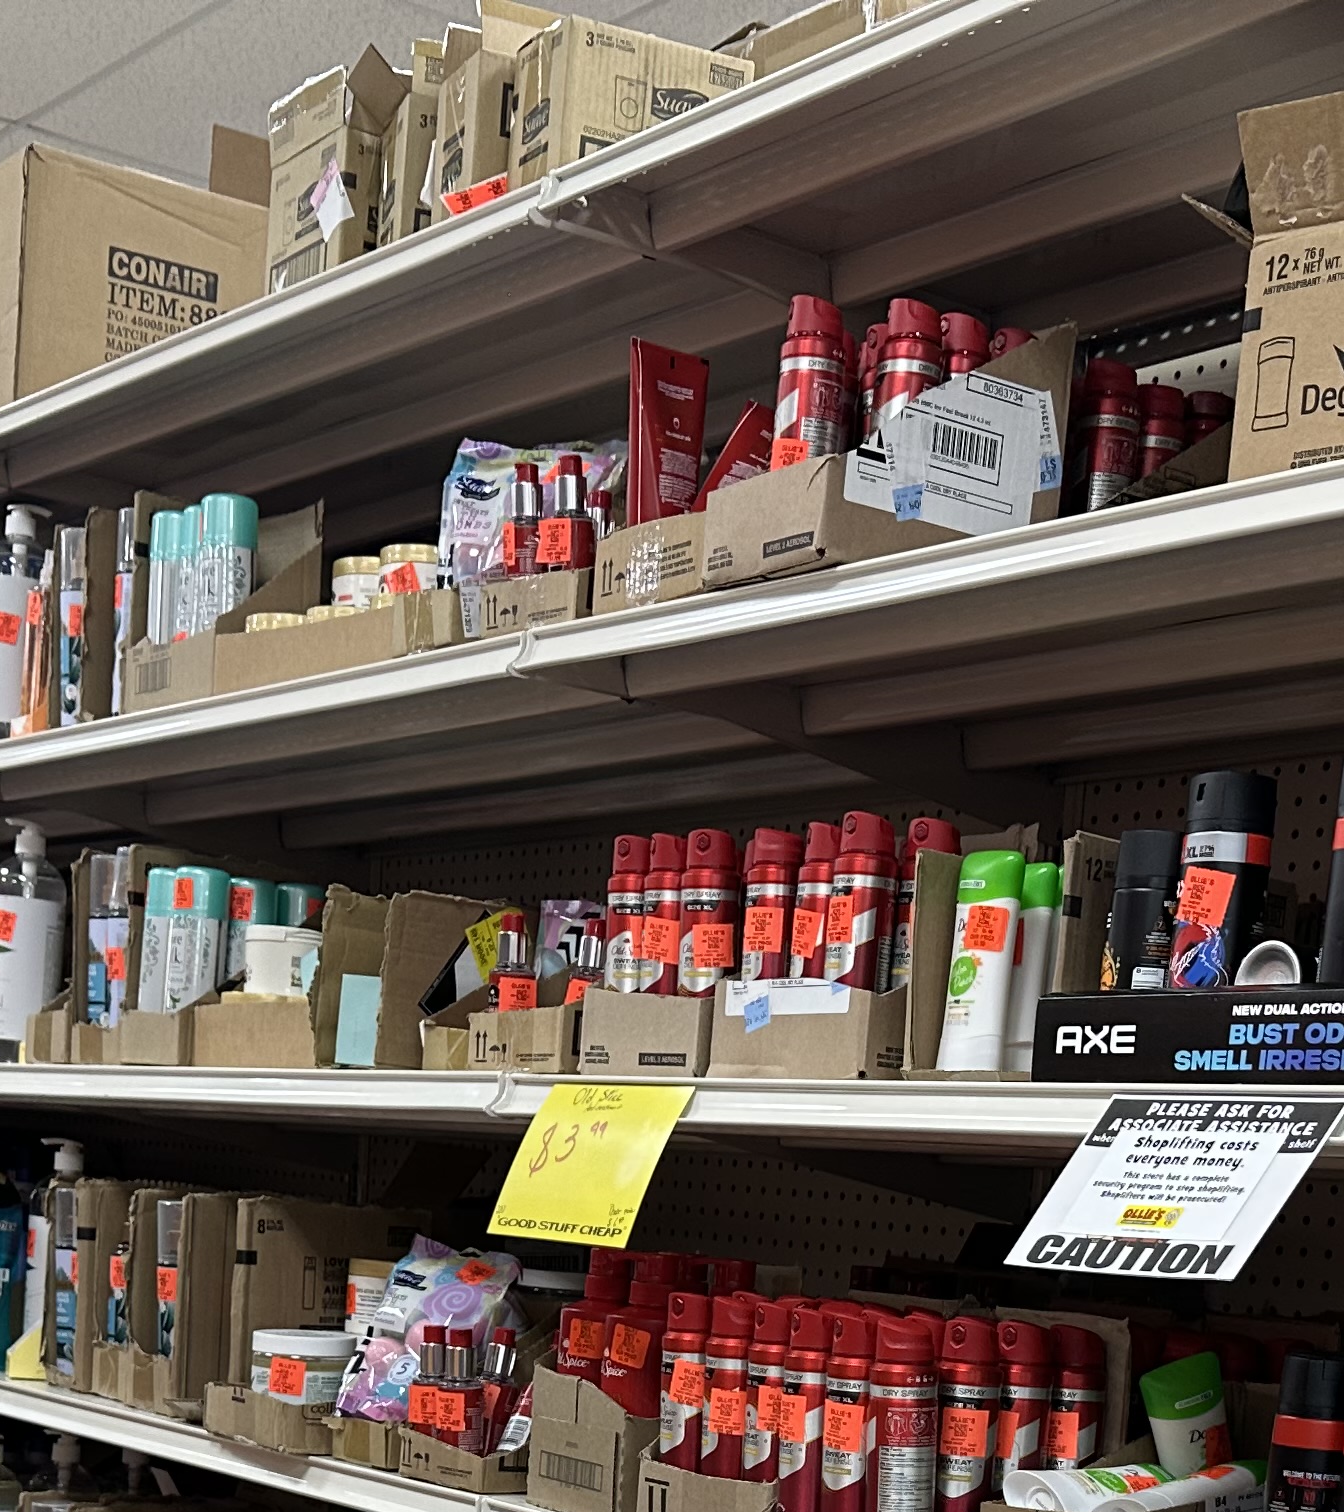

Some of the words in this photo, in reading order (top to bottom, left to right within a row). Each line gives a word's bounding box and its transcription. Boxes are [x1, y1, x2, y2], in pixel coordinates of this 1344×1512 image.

[1304, 247, 1317, 260] 76
[1318, 247, 1325, 261] g
[111, 250, 208, 299] CONAIR
[1265, 253, 1288, 282] 12
[1303, 260, 1321, 275] NET
[1232, 1004, 1262, 1017] NEW
[1264, 1003, 1298, 1016] DUAL
[1055, 1024, 1137, 1055] AXE
[1228, 1022, 1299, 1045] BUST
[1173, 1049, 1252, 1072] SMELL
[1146, 1102, 1213, 1118] PLEASE
[1214, 1103, 1254, 1118] ASK
[1257, 1104, 1295, 1119] FOR
[1108, 1118, 1205, 1131] ASSOCIATE
[1207, 1120, 1318, 1136] ASSISTANCE
[1134, 1135, 1216, 1153] Shoplifting
[1220, 1139, 1260, 1152] costs
[1126, 1153, 1189, 1168] everyone
[1193, 1155, 1245, 1171] money.
[1123, 1171, 1140, 1180] This
[1143, 1173, 1164, 1181] store
[1166, 1172, 1181, 1181] has
[1191, 1174, 1230, 1184] complete
[1093, 1180, 1127, 1190] security
[1128, 1183, 1163, 1192] program
[1177, 1184, 1195, 1193] stop
[1149, 1192, 1165, 1201] will
[1167, 1193, 1176, 1201] be
[1122, 1207, 1167, 1222] OLLIE'S
[538, 1220, 577, 1235] STUFF
[1026, 1232, 1236, 1275] CAUTION
[882, 1388, 899, 1397] DRY
[901, 1389, 928, 1398] SPRAY
[958, 1387, 986, 1397] SPRAY
